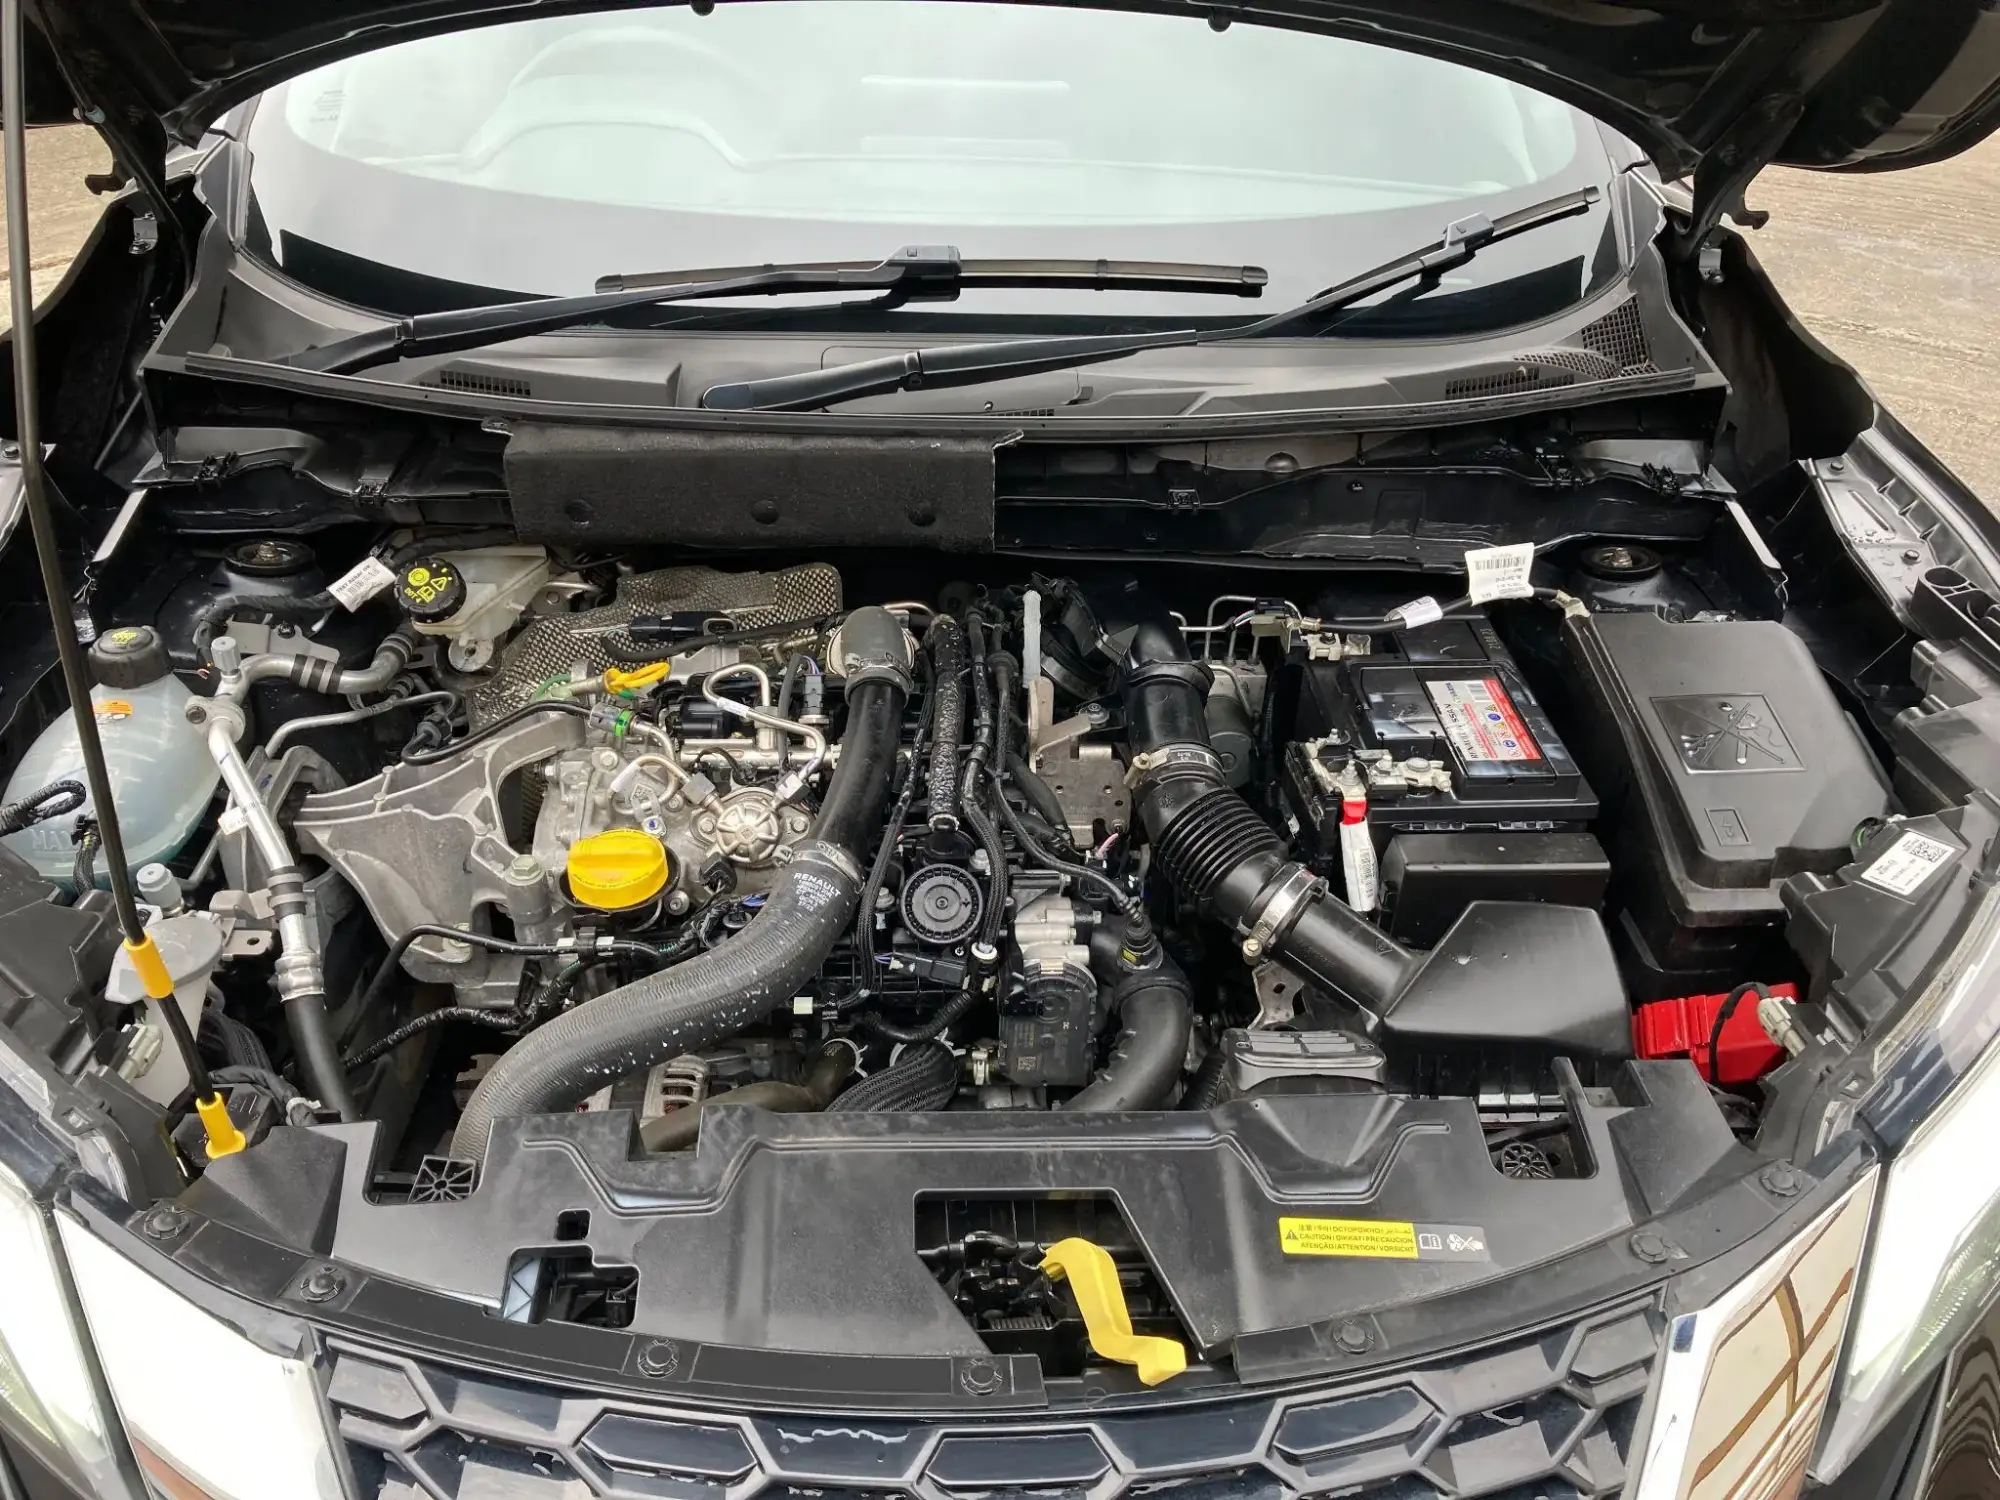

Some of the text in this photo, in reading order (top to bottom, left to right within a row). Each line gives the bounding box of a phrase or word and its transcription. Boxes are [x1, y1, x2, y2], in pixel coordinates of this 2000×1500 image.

[404, 587, 418, 599] DOT
[793, 872, 842, 898] RENAULT
[1299, 1233, 1332, 1241] CAUTION
[1337, 1243, 1376, 1251] ATTENTION
[1379, 1245, 1414, 1253] VORSICHT
